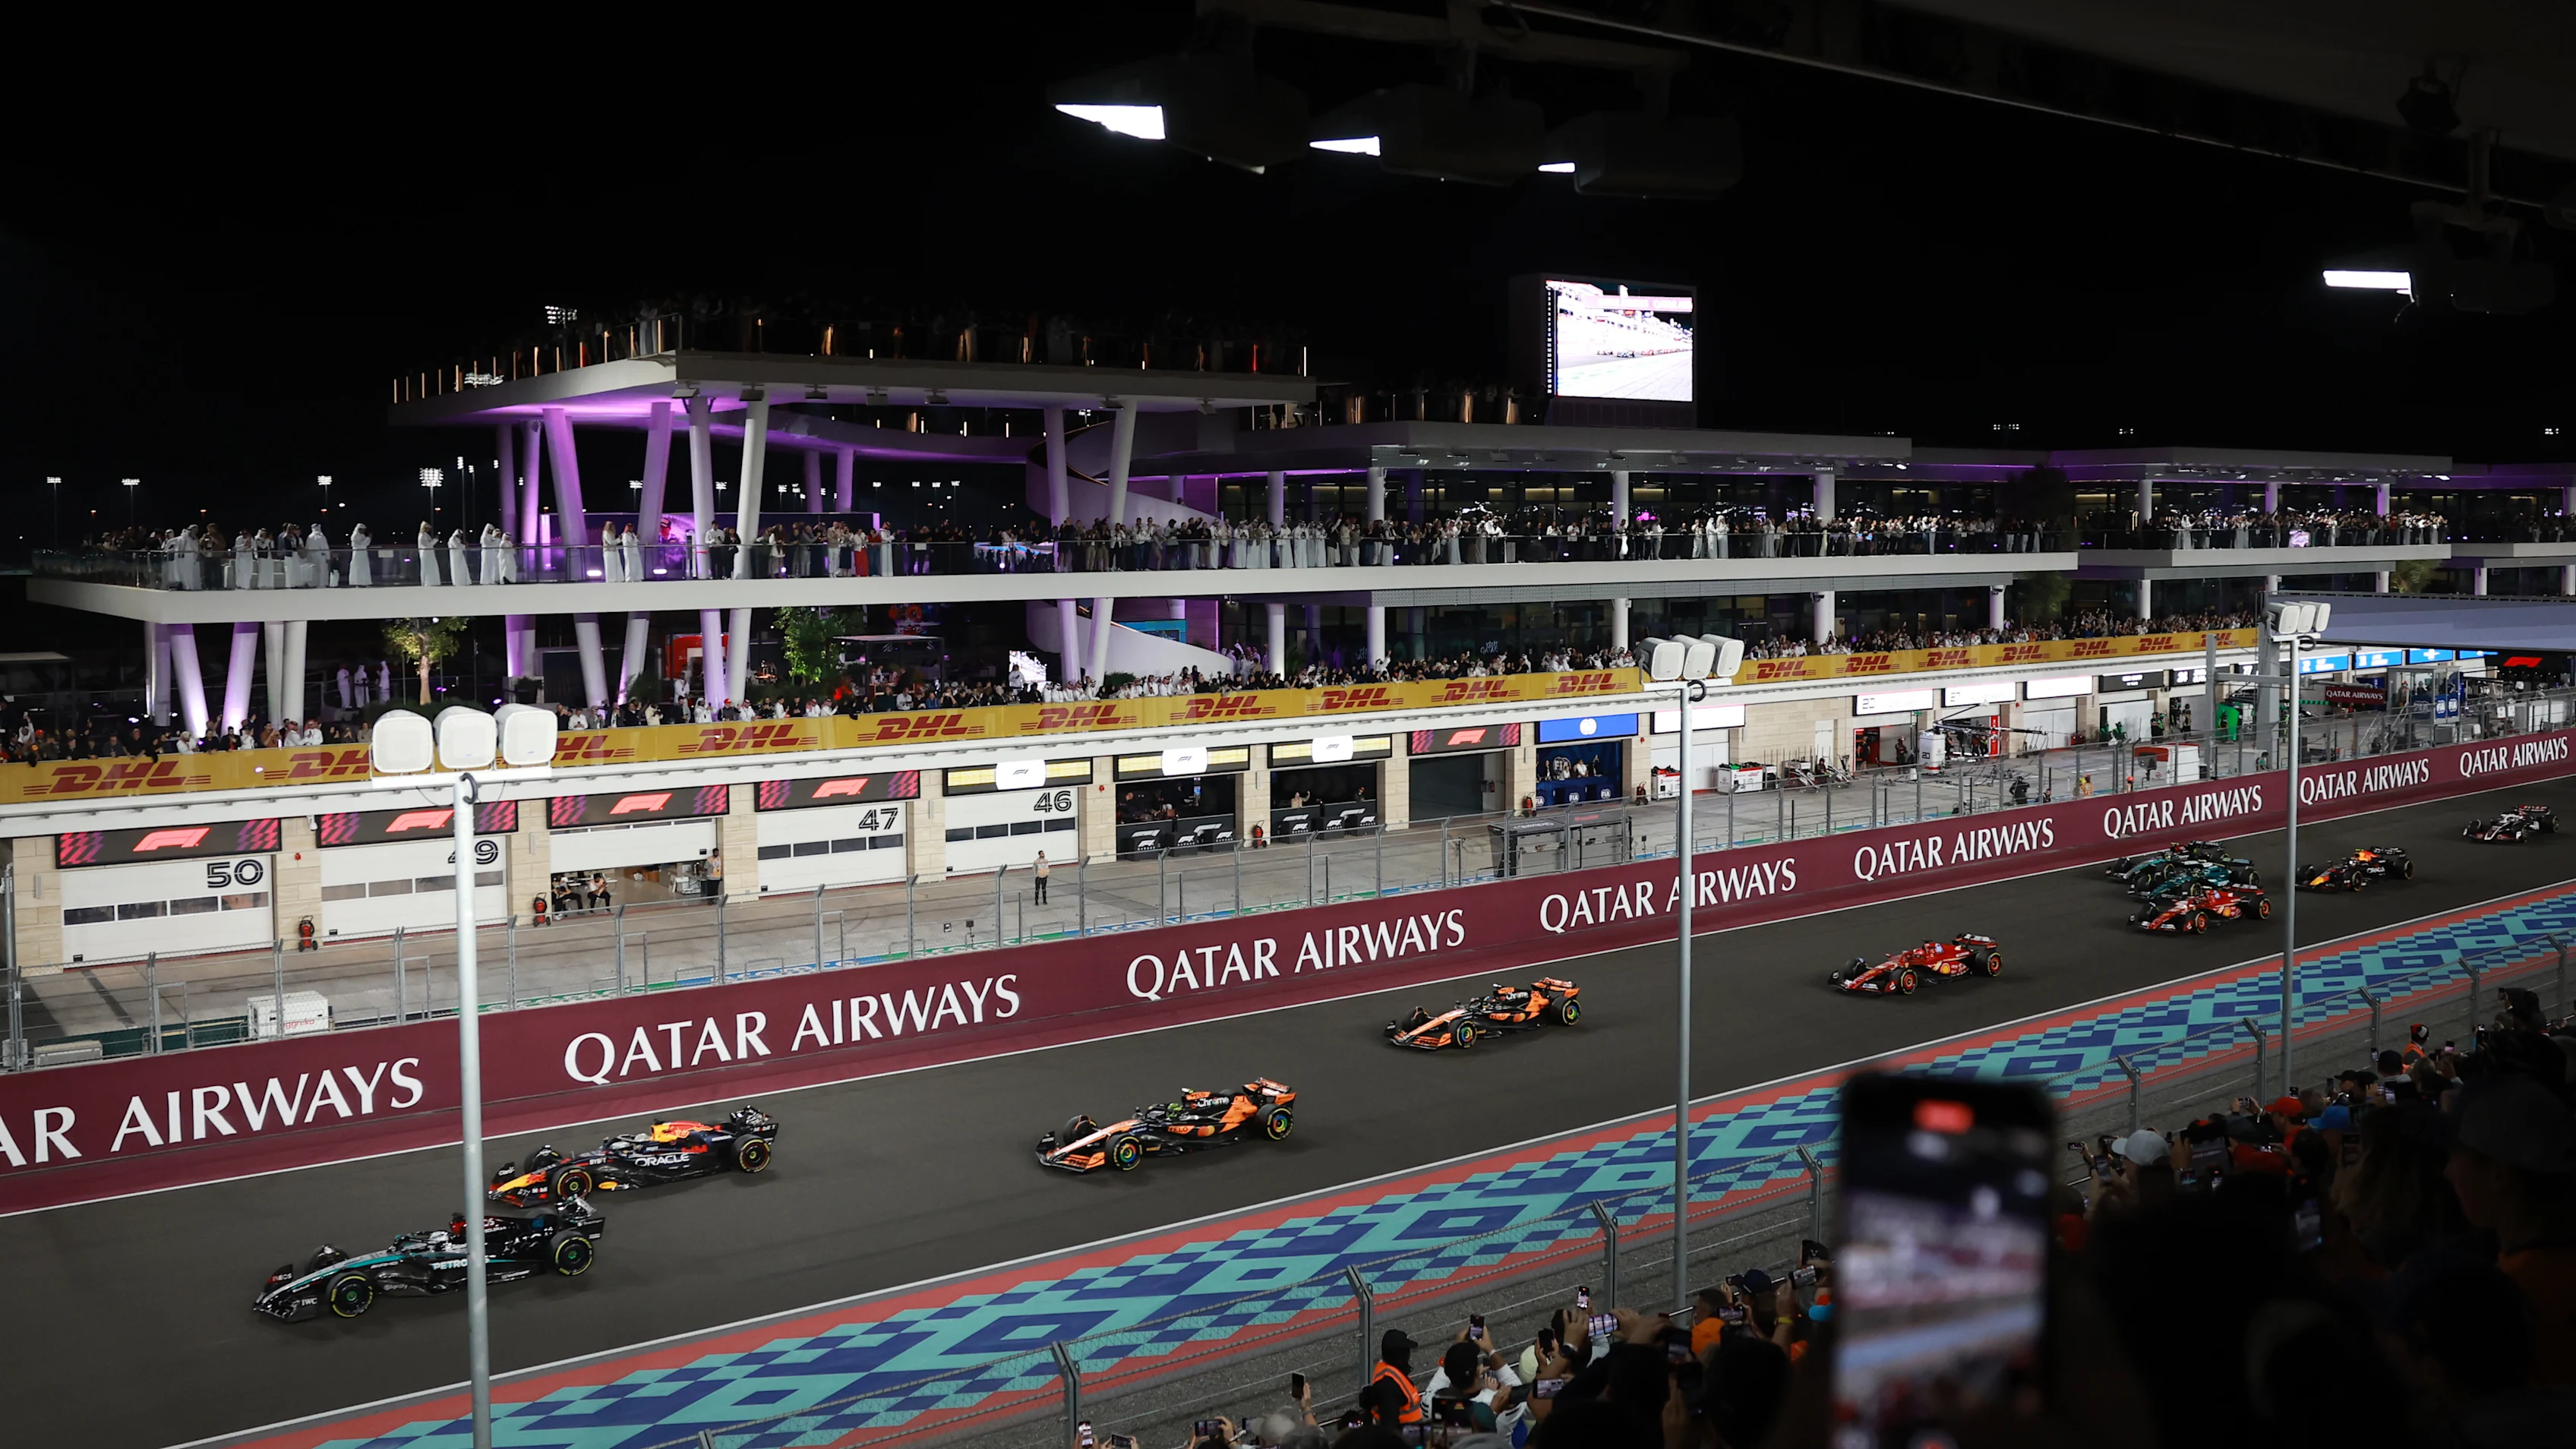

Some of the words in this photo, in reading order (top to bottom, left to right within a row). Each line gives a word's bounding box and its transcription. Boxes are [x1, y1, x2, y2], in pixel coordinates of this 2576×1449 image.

[2003, 646, 2043, 661] DHL
[2074, 640, 2110, 656] DHL
[2139, 636, 2174, 652] DHL
[1757, 661, 1807, 680] DHL
[1845, 655, 1892, 673] DHL
[1927, 650, 1969, 667] DHL
[1444, 680, 1508, 701] DHL
[1558, 674, 1616, 694] DHL
[2326, 690, 2350, 699] QATAR
[2351, 690, 2384, 701] AIRWAYS
[1185, 696, 1261, 719] DHL
[1320, 687, 1391, 710] DHL
[876, 714, 968, 740] DHL
[1036, 705, 1121, 730] DHL
[553, 735, 614, 760] HL
[698, 724, 799, 751] DHL
[289, 750, 371, 778] DH
[2460, 747, 2508, 778] QATAR
[2511, 737, 2568, 769] AIRWAYS
[49, 761, 185, 794] DHL
[2300, 771, 2358, 806] QATAR
[2362, 759, 2429, 794] AIRWAYS
[1034, 791, 1072, 813] 46
[2104, 800, 2175, 840] QATAR
[2180, 784, 2262, 826] AIRWAYS
[859, 807, 898, 832] 47
[1855, 836, 1944, 882] QATAR
[1951, 818, 2054, 864] AIRWAYS
[207, 859, 264, 888] 50
[1540, 881, 1656, 934] QATAR
[1127, 938, 1280, 1002] QATAR
[1294, 909, 1466, 974] AIRWAYS
[564, 1011, 772, 1085] QATAR
[791, 974, 1023, 1052] AIRWAYS
[110, 1057, 425, 1153] AIRWAYS
[1198, 1096, 1230, 1108] Chrome
[635, 1154, 690, 1167] ORACLE
[272, 1272, 292, 1282] INEOS
[301, 1297, 317, 1306] IWC
